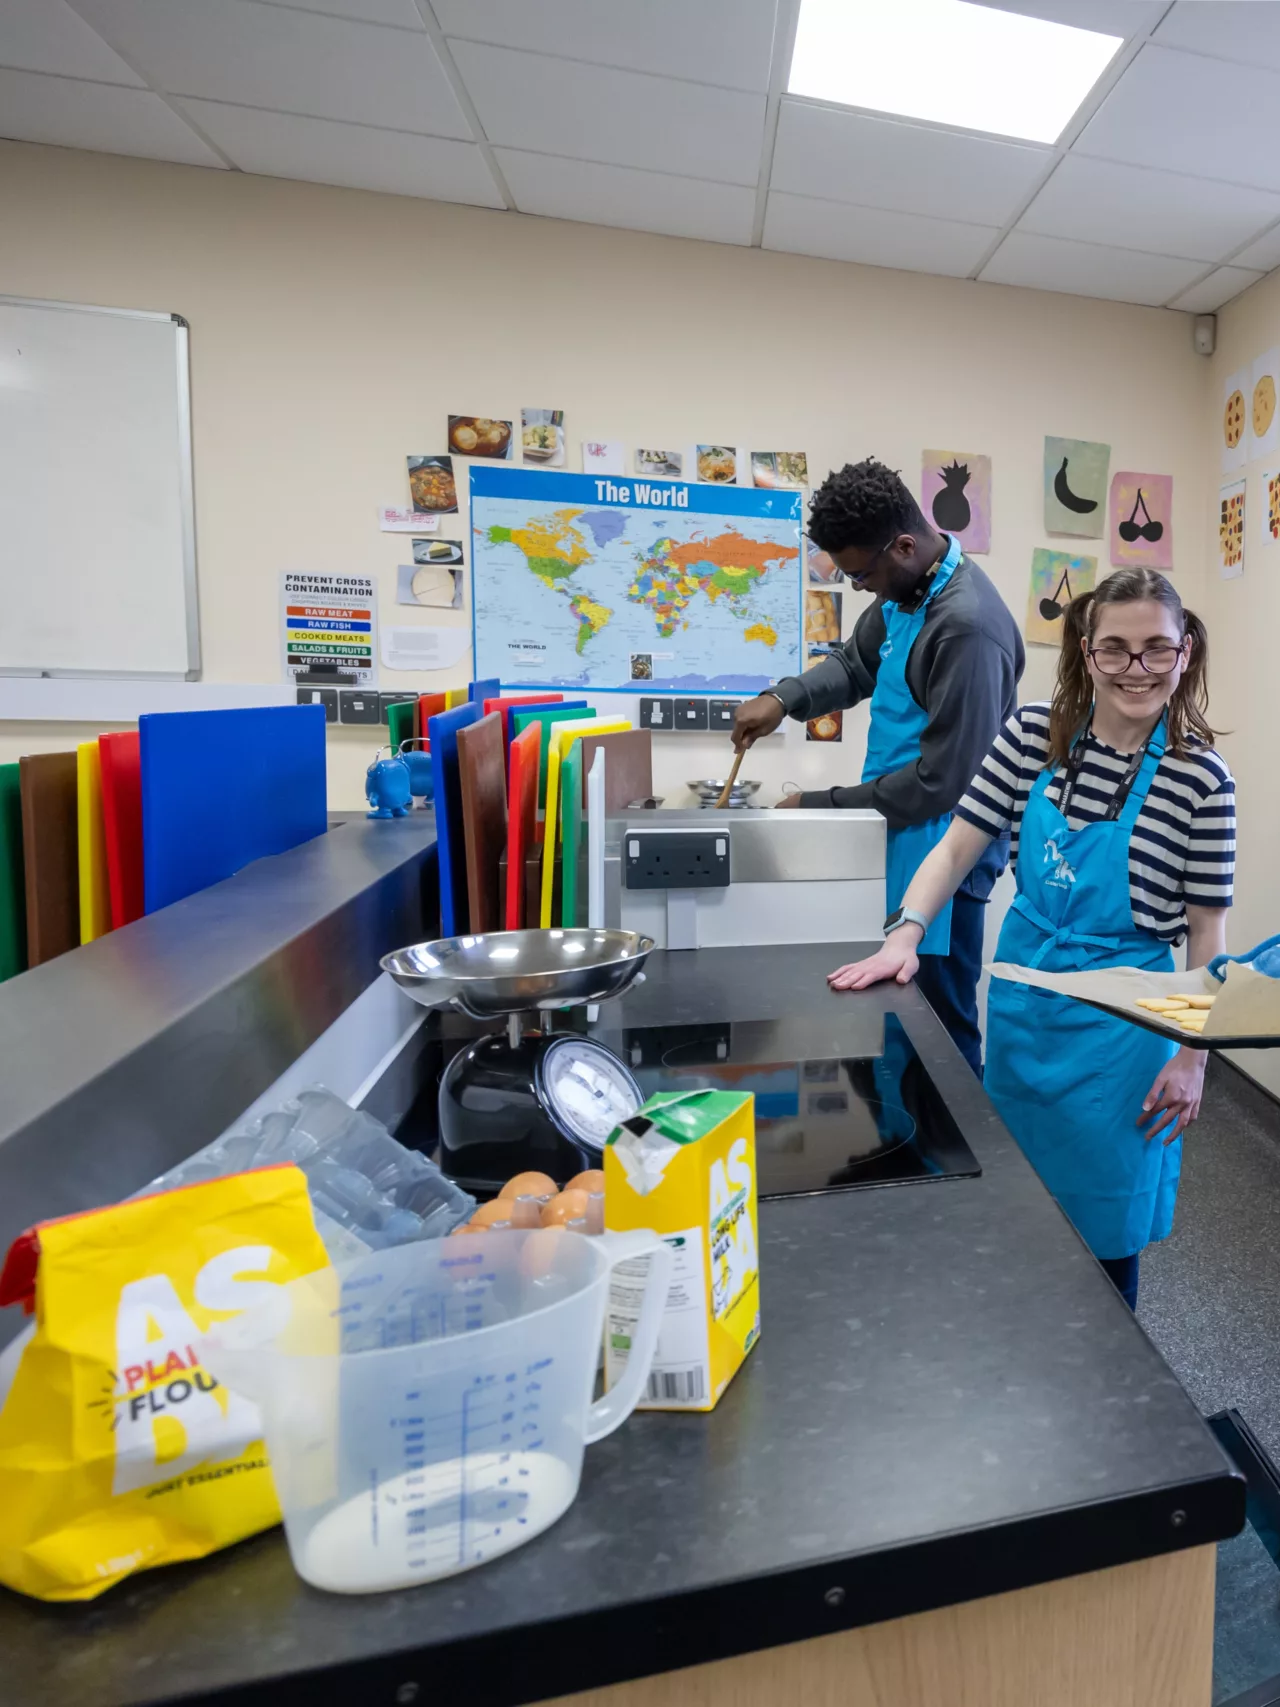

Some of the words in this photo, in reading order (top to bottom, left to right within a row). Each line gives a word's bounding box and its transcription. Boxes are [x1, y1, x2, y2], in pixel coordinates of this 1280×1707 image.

[587, 442, 608, 457] UK
[594, 480, 630, 503] The
[634, 483, 689, 508] World
[286, 574, 333, 584] PREVENT
[336, 577, 372, 587] CROSS
[285, 584, 373, 596] CONTAMINATION
[305, 608, 326, 616] RAW
[328, 609, 354, 617] MEAT
[294, 632, 333, 640] COOKED
[335, 634, 365, 642] MEATS
[291, 644, 327, 652] SALADS
[336, 647, 368, 655] FRUITS
[123, 1341, 202, 1393] PLAI
[128, 1371, 219, 1422] FLOU
[185, 1457, 271, 1487] ESSENTIAL
